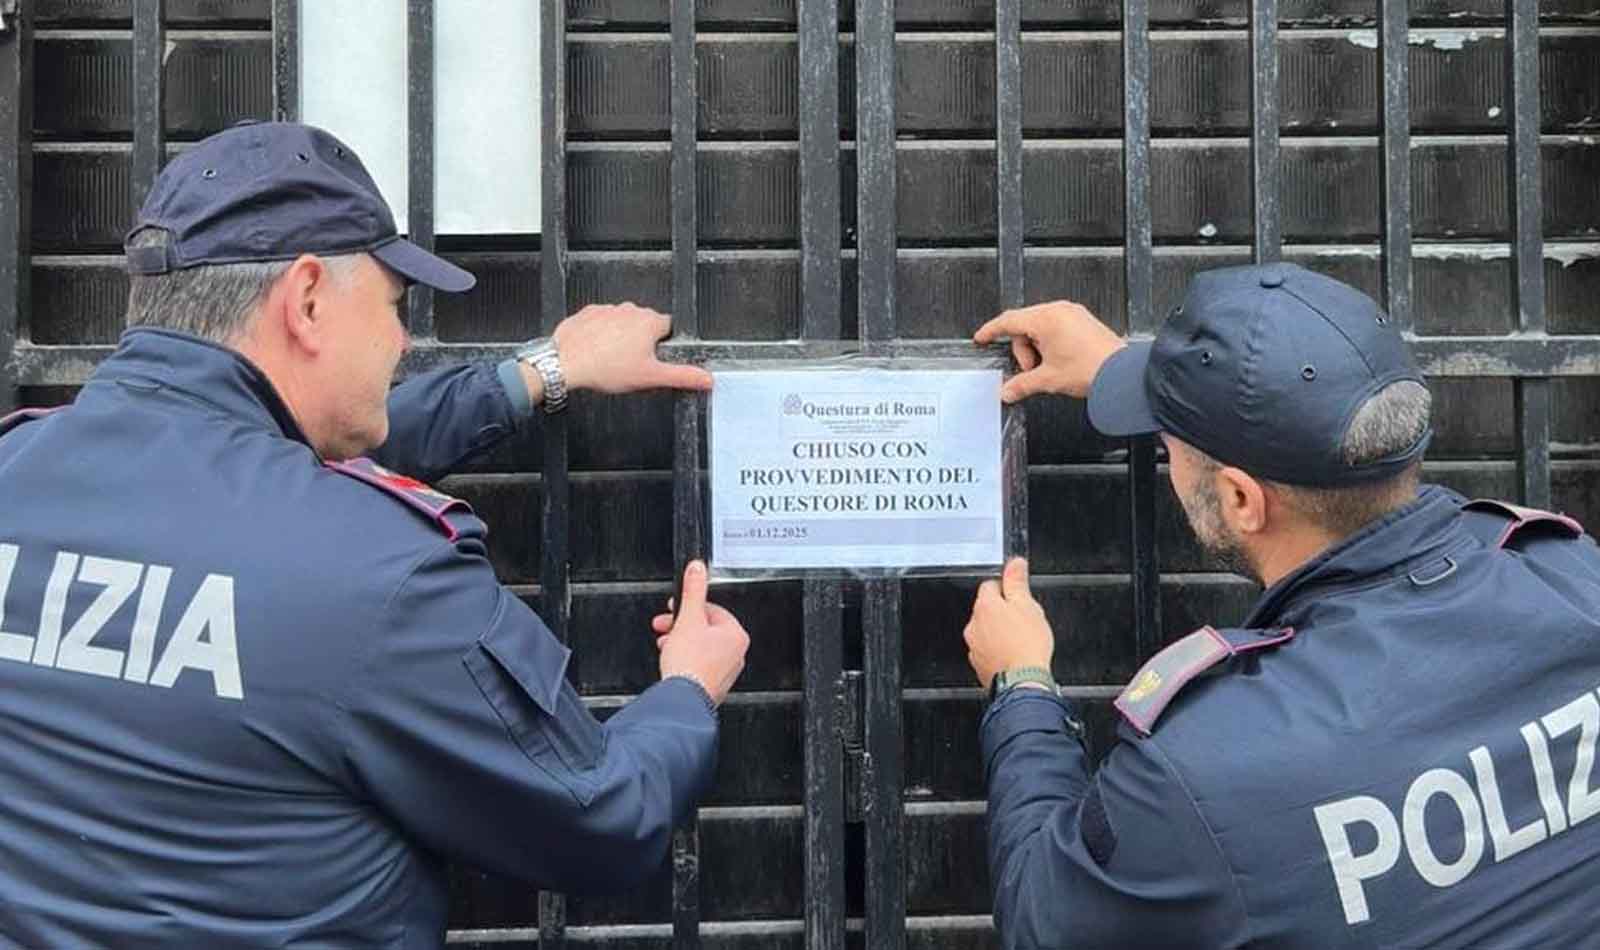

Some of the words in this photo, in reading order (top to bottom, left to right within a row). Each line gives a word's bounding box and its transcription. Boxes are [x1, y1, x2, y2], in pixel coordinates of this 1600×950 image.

[803, 401, 871, 418] Questura
[874, 401, 889, 416] di
[894, 402, 936, 416] Roma
[793, 441, 874, 459] CHIUSO
[881, 441, 928, 458] CON
[740, 468, 932, 486] PROVVEDIMENTO
[938, 467, 980, 484] DEL
[751, 495, 869, 515] QUESTORE
[876, 495, 897, 511] DI
[904, 494, 968, 510] ROMA
[749, 527, 808, 539] 01.12.2025
[1313, 686, 1600, 924] POLIZ
